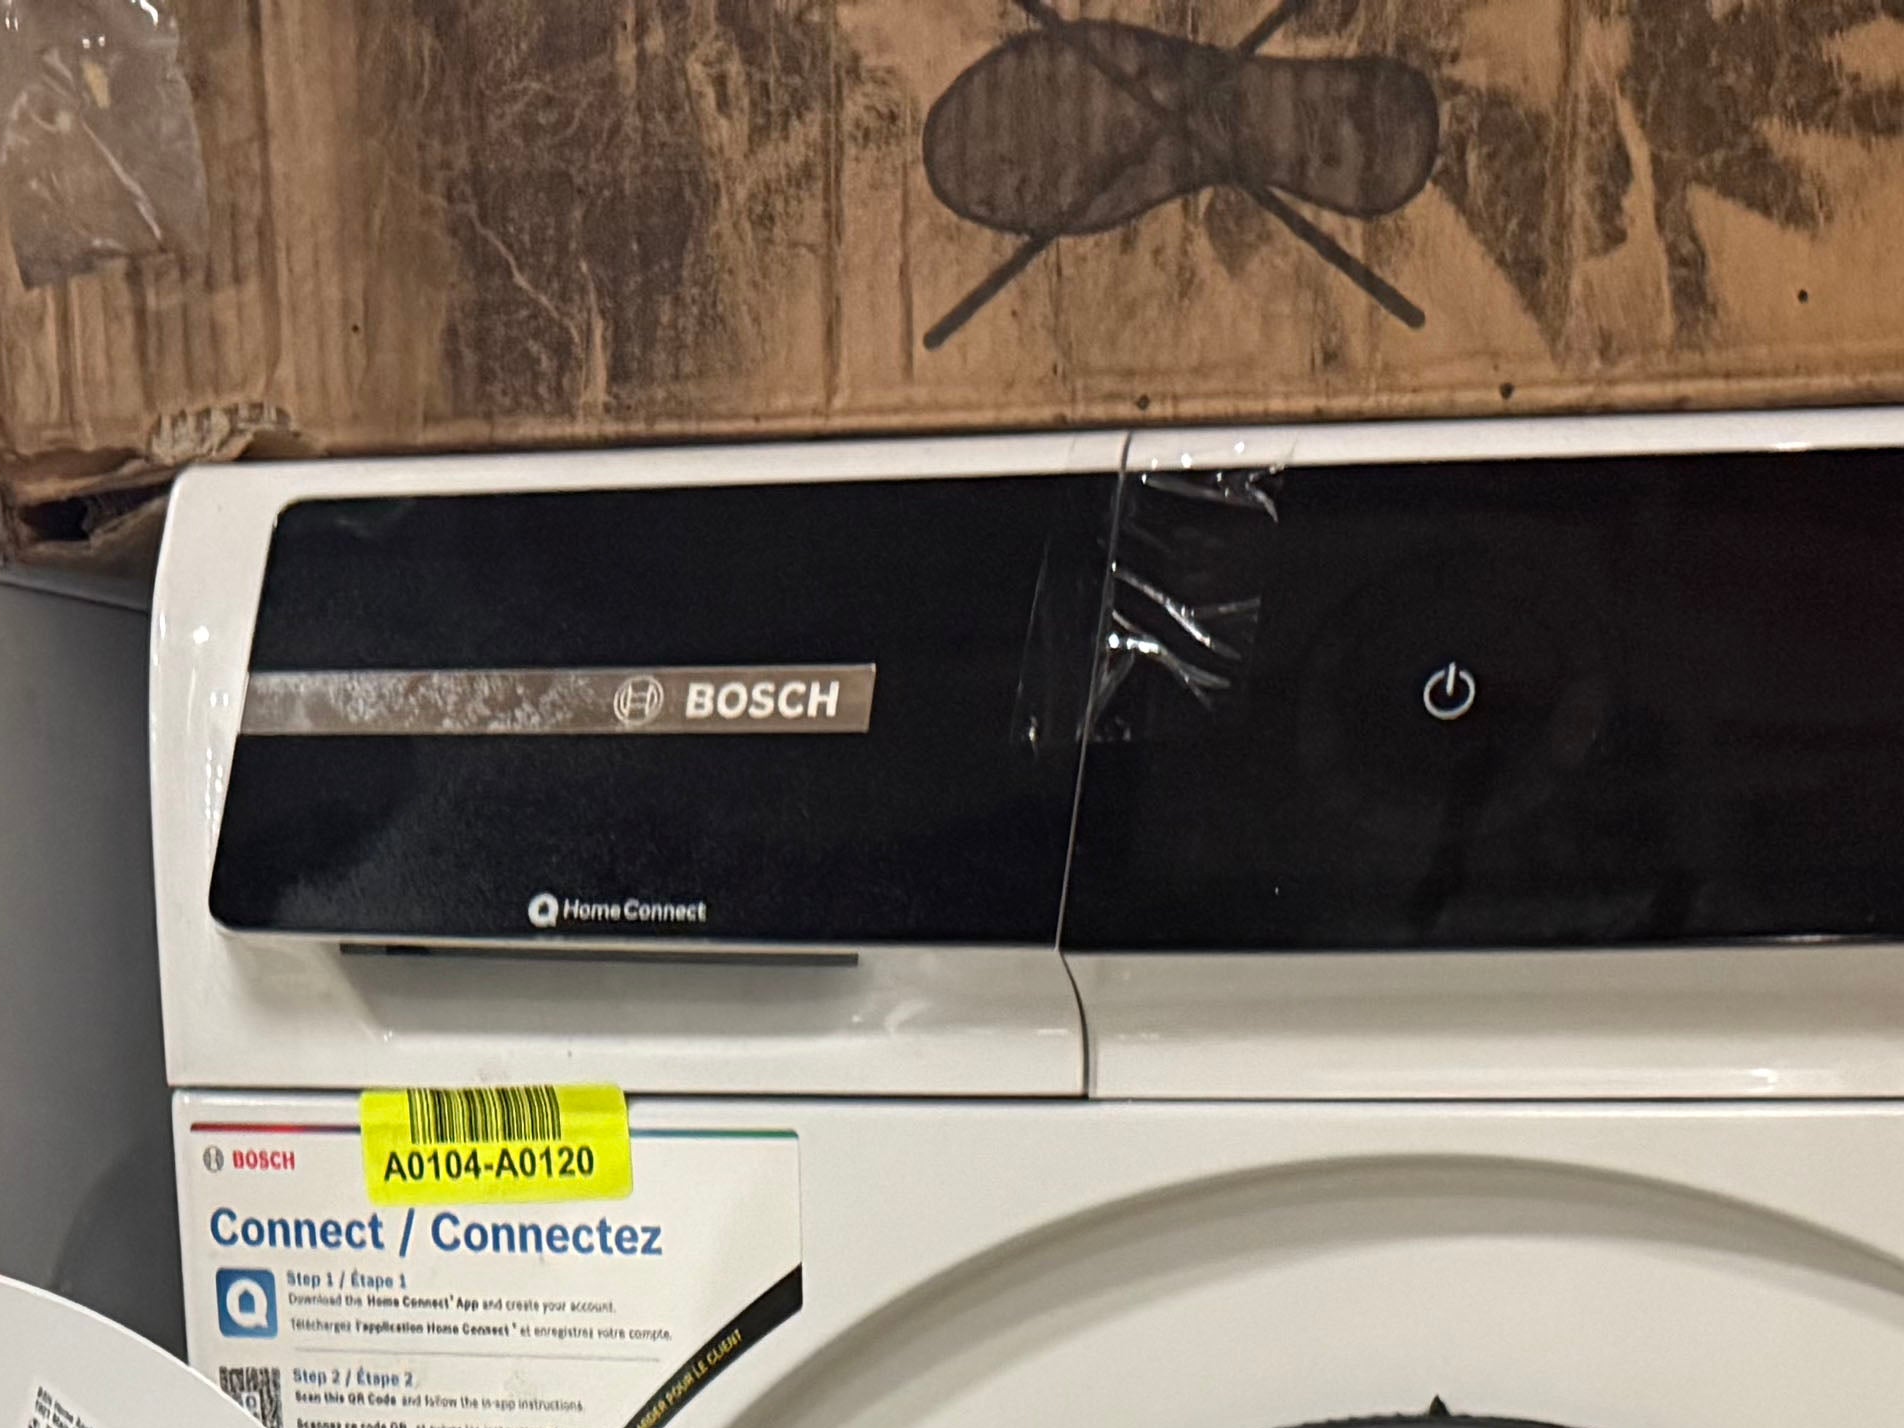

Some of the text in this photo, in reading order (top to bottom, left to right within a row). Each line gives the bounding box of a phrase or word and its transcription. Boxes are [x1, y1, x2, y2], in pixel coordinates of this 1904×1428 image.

[686, 681, 840, 719] BOSCH
[563, 899, 706, 924] Home Connect
[232, 1150, 296, 1171] BOSCH
[383, 1146, 595, 1183] A0104-A0120
[209, 1207, 663, 1257] Connect / Connectez
[287, 1270, 321, 1290] Step
[351, 1267, 394, 1290] Étape
[367, 1294, 399, 1308] Home
[293, 1368, 326, 1387] Step
[331, 1370, 340, 1385] 2
[357, 1366, 400, 1388] Étape
[404, 1373, 413, 1388] 2
